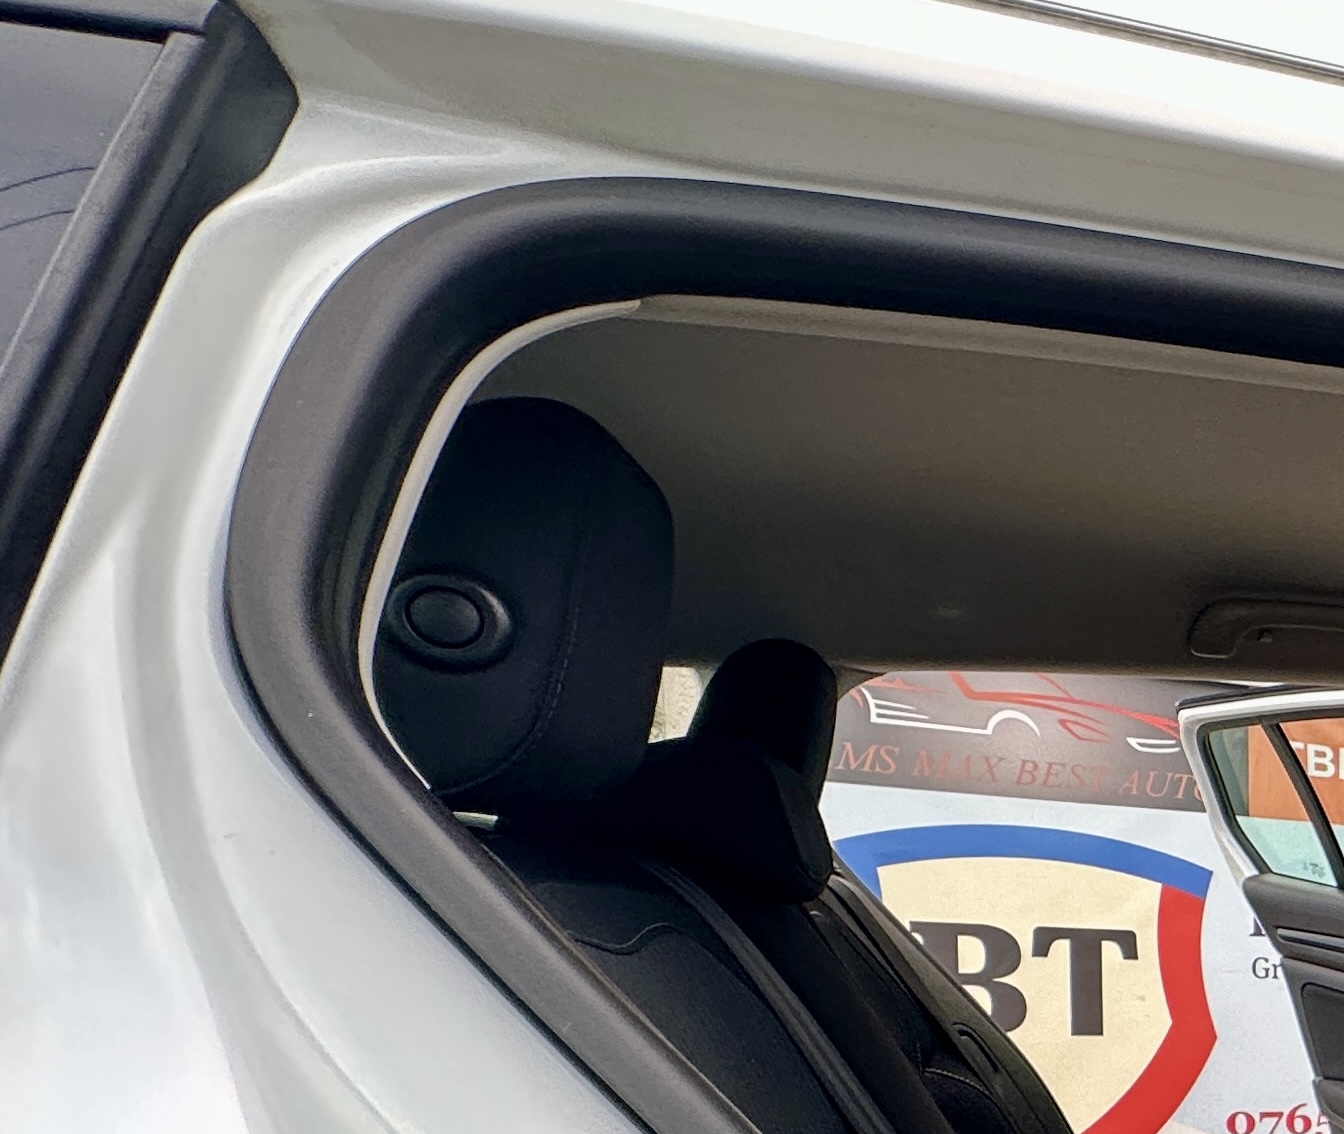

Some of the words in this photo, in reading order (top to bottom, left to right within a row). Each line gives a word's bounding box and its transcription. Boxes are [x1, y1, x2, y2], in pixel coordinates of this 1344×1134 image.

[912, 750, 1008, 785] MAX
[1014, 758, 1112, 790] BEST
[909, 921, 1139, 1036] BT
